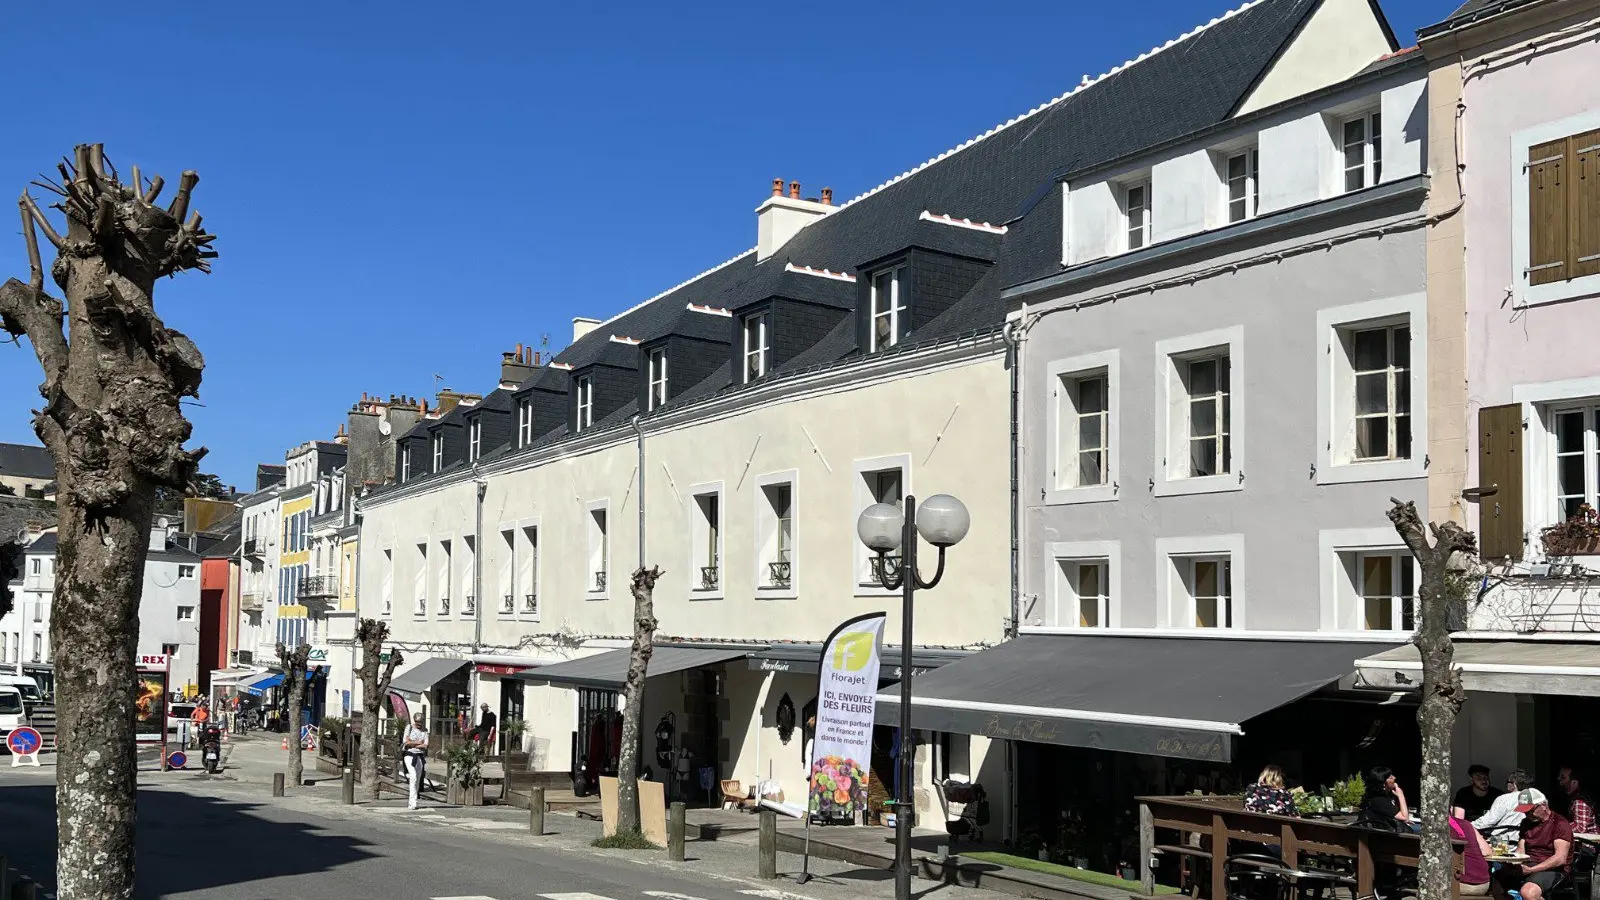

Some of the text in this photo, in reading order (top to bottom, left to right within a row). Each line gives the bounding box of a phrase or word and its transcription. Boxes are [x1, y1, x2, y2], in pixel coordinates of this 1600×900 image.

[142, 655, 165, 664] REX
[831, 672, 866, 686] Florajet
[838, 692, 873, 704] ENVOYEZ
[823, 700, 873, 714] DES FLEURS
[821, 716, 871, 728] Livraison partout
[835, 726, 857, 735] France
[820, 734, 836, 742] dans
